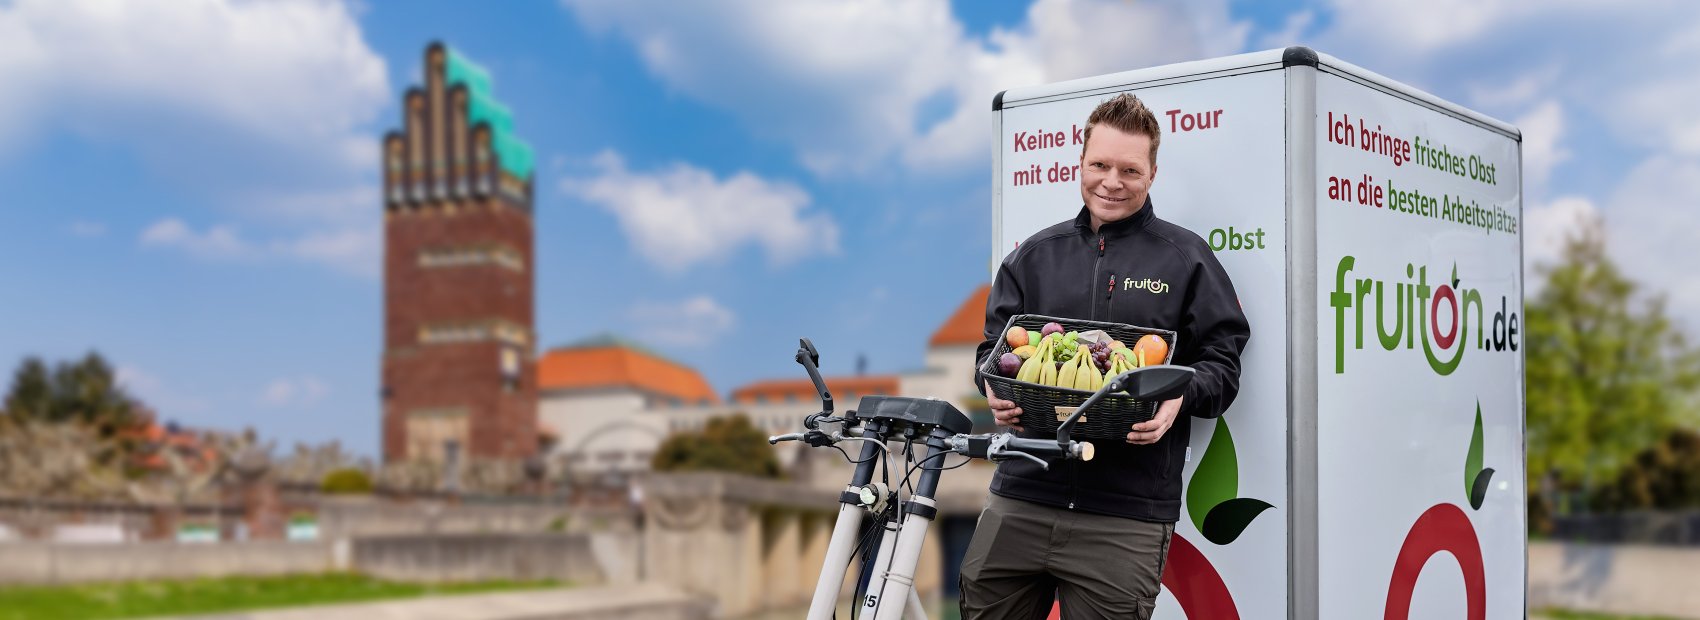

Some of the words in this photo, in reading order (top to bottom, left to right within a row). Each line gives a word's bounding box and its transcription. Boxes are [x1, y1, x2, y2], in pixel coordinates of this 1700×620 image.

[1014, 129, 1066, 152] Keine
[1165, 109, 1223, 133] Tour
[1328, 111, 1355, 147] Ich
[1360, 118, 1411, 166] bringe
[1414, 135, 1466, 177] frisches
[1469, 154, 1496, 186] Obst
[1014, 164, 1042, 186] mit
[1047, 161, 1080, 183] der
[1328, 176, 1352, 202] an
[1357, 174, 1383, 208] die
[1388, 179, 1438, 218] besten
[1442, 194, 1517, 235] Arbeitsplätze
[1208, 226, 1266, 252] Obst
[1123, 277, 1169, 294] fruiton
